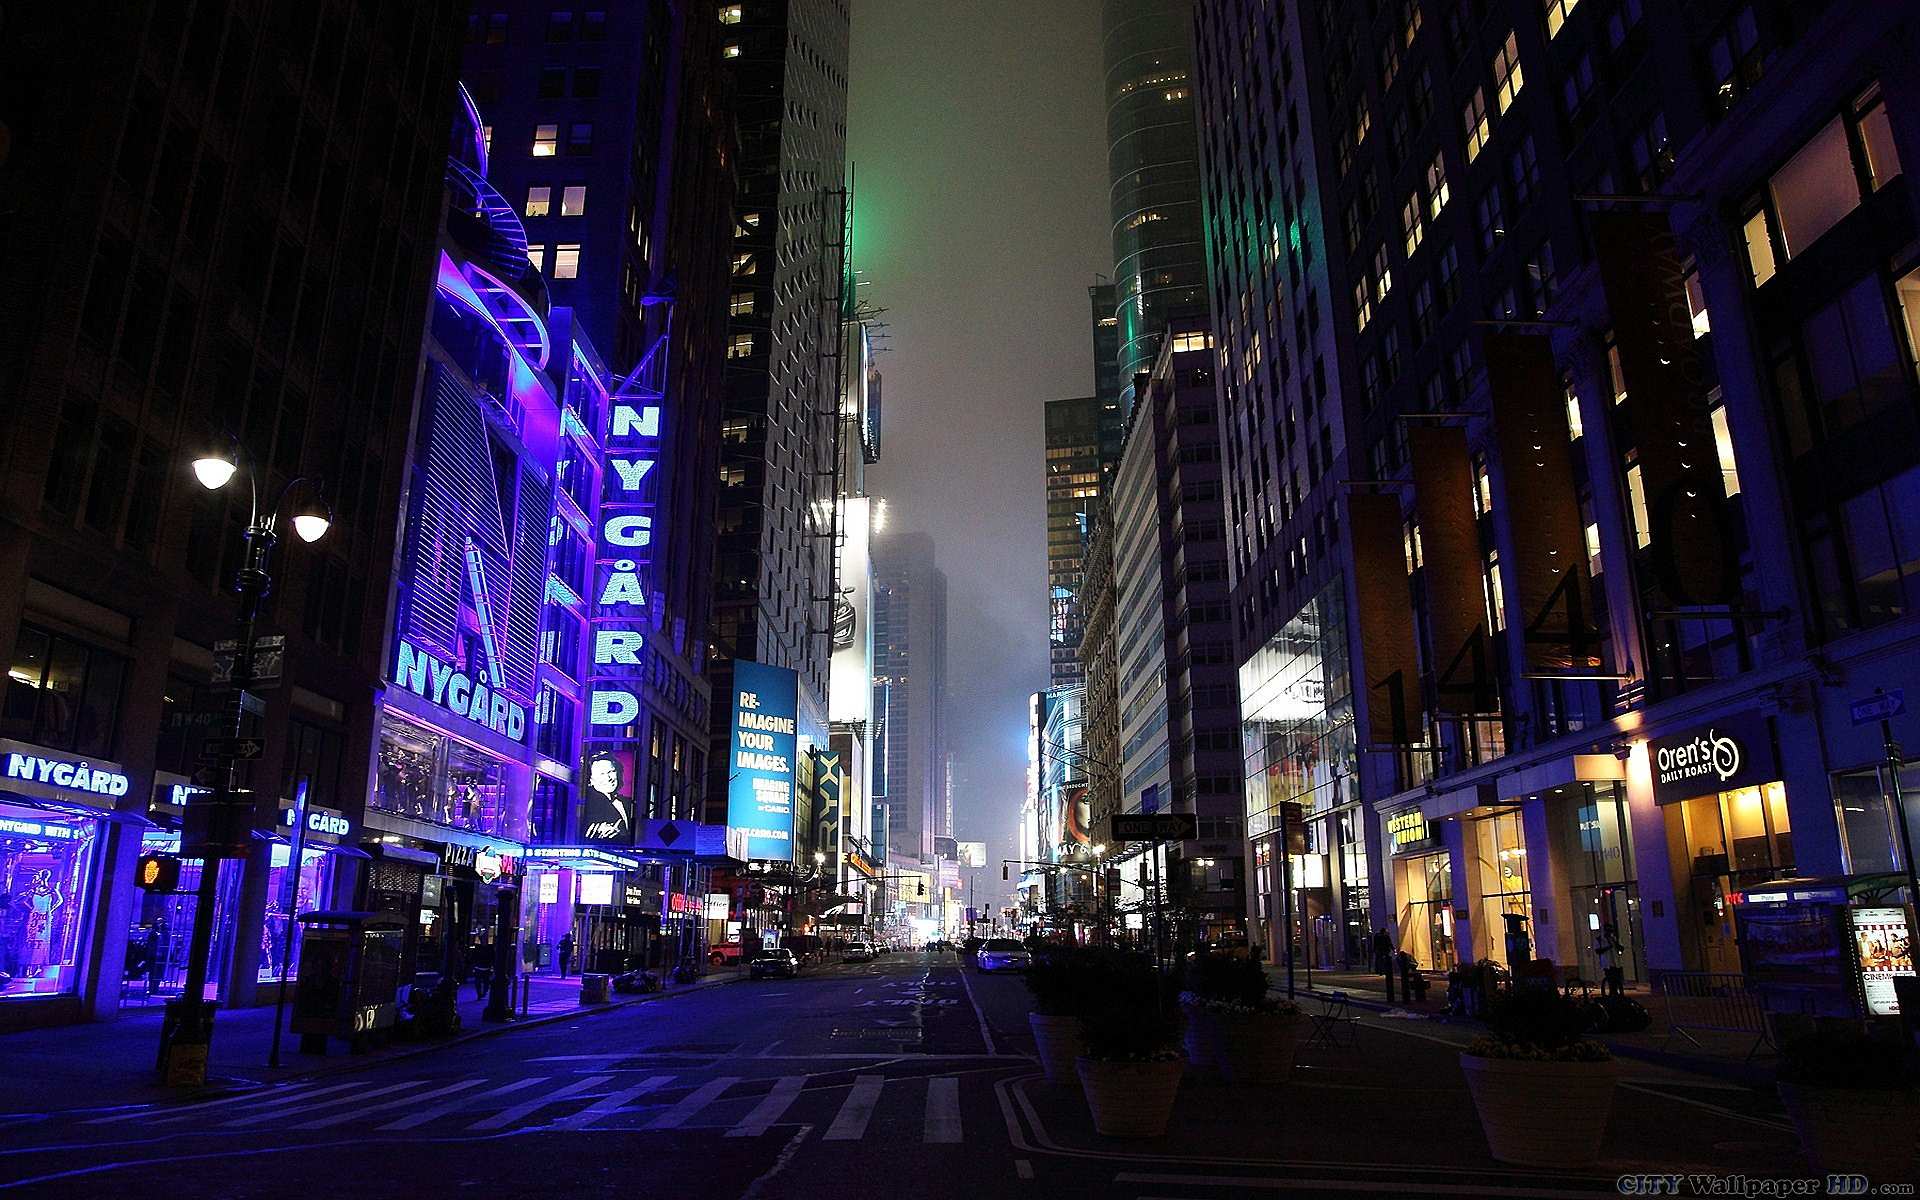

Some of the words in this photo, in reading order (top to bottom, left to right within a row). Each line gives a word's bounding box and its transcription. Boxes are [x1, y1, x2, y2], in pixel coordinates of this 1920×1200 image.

[590, 405, 659, 725] NYGÅRD
[394, 640, 525, 741] NYGÅRD
[740, 692, 761, 708] RE-
[739, 712, 794, 734] IMAGINE
[738, 731, 774, 751] YOUR
[737, 751, 790, 772] IMAGES.
[8, 753, 129, 796] NYGÅRD
[1661, 769, 1683, 784] DAILY
[1685, 762, 1712, 777] ROAST
[1387, 812, 1421, 834] WESTERN
[1396, 826, 1423, 845] UNION
[445, 842, 474, 867] PIZZA
